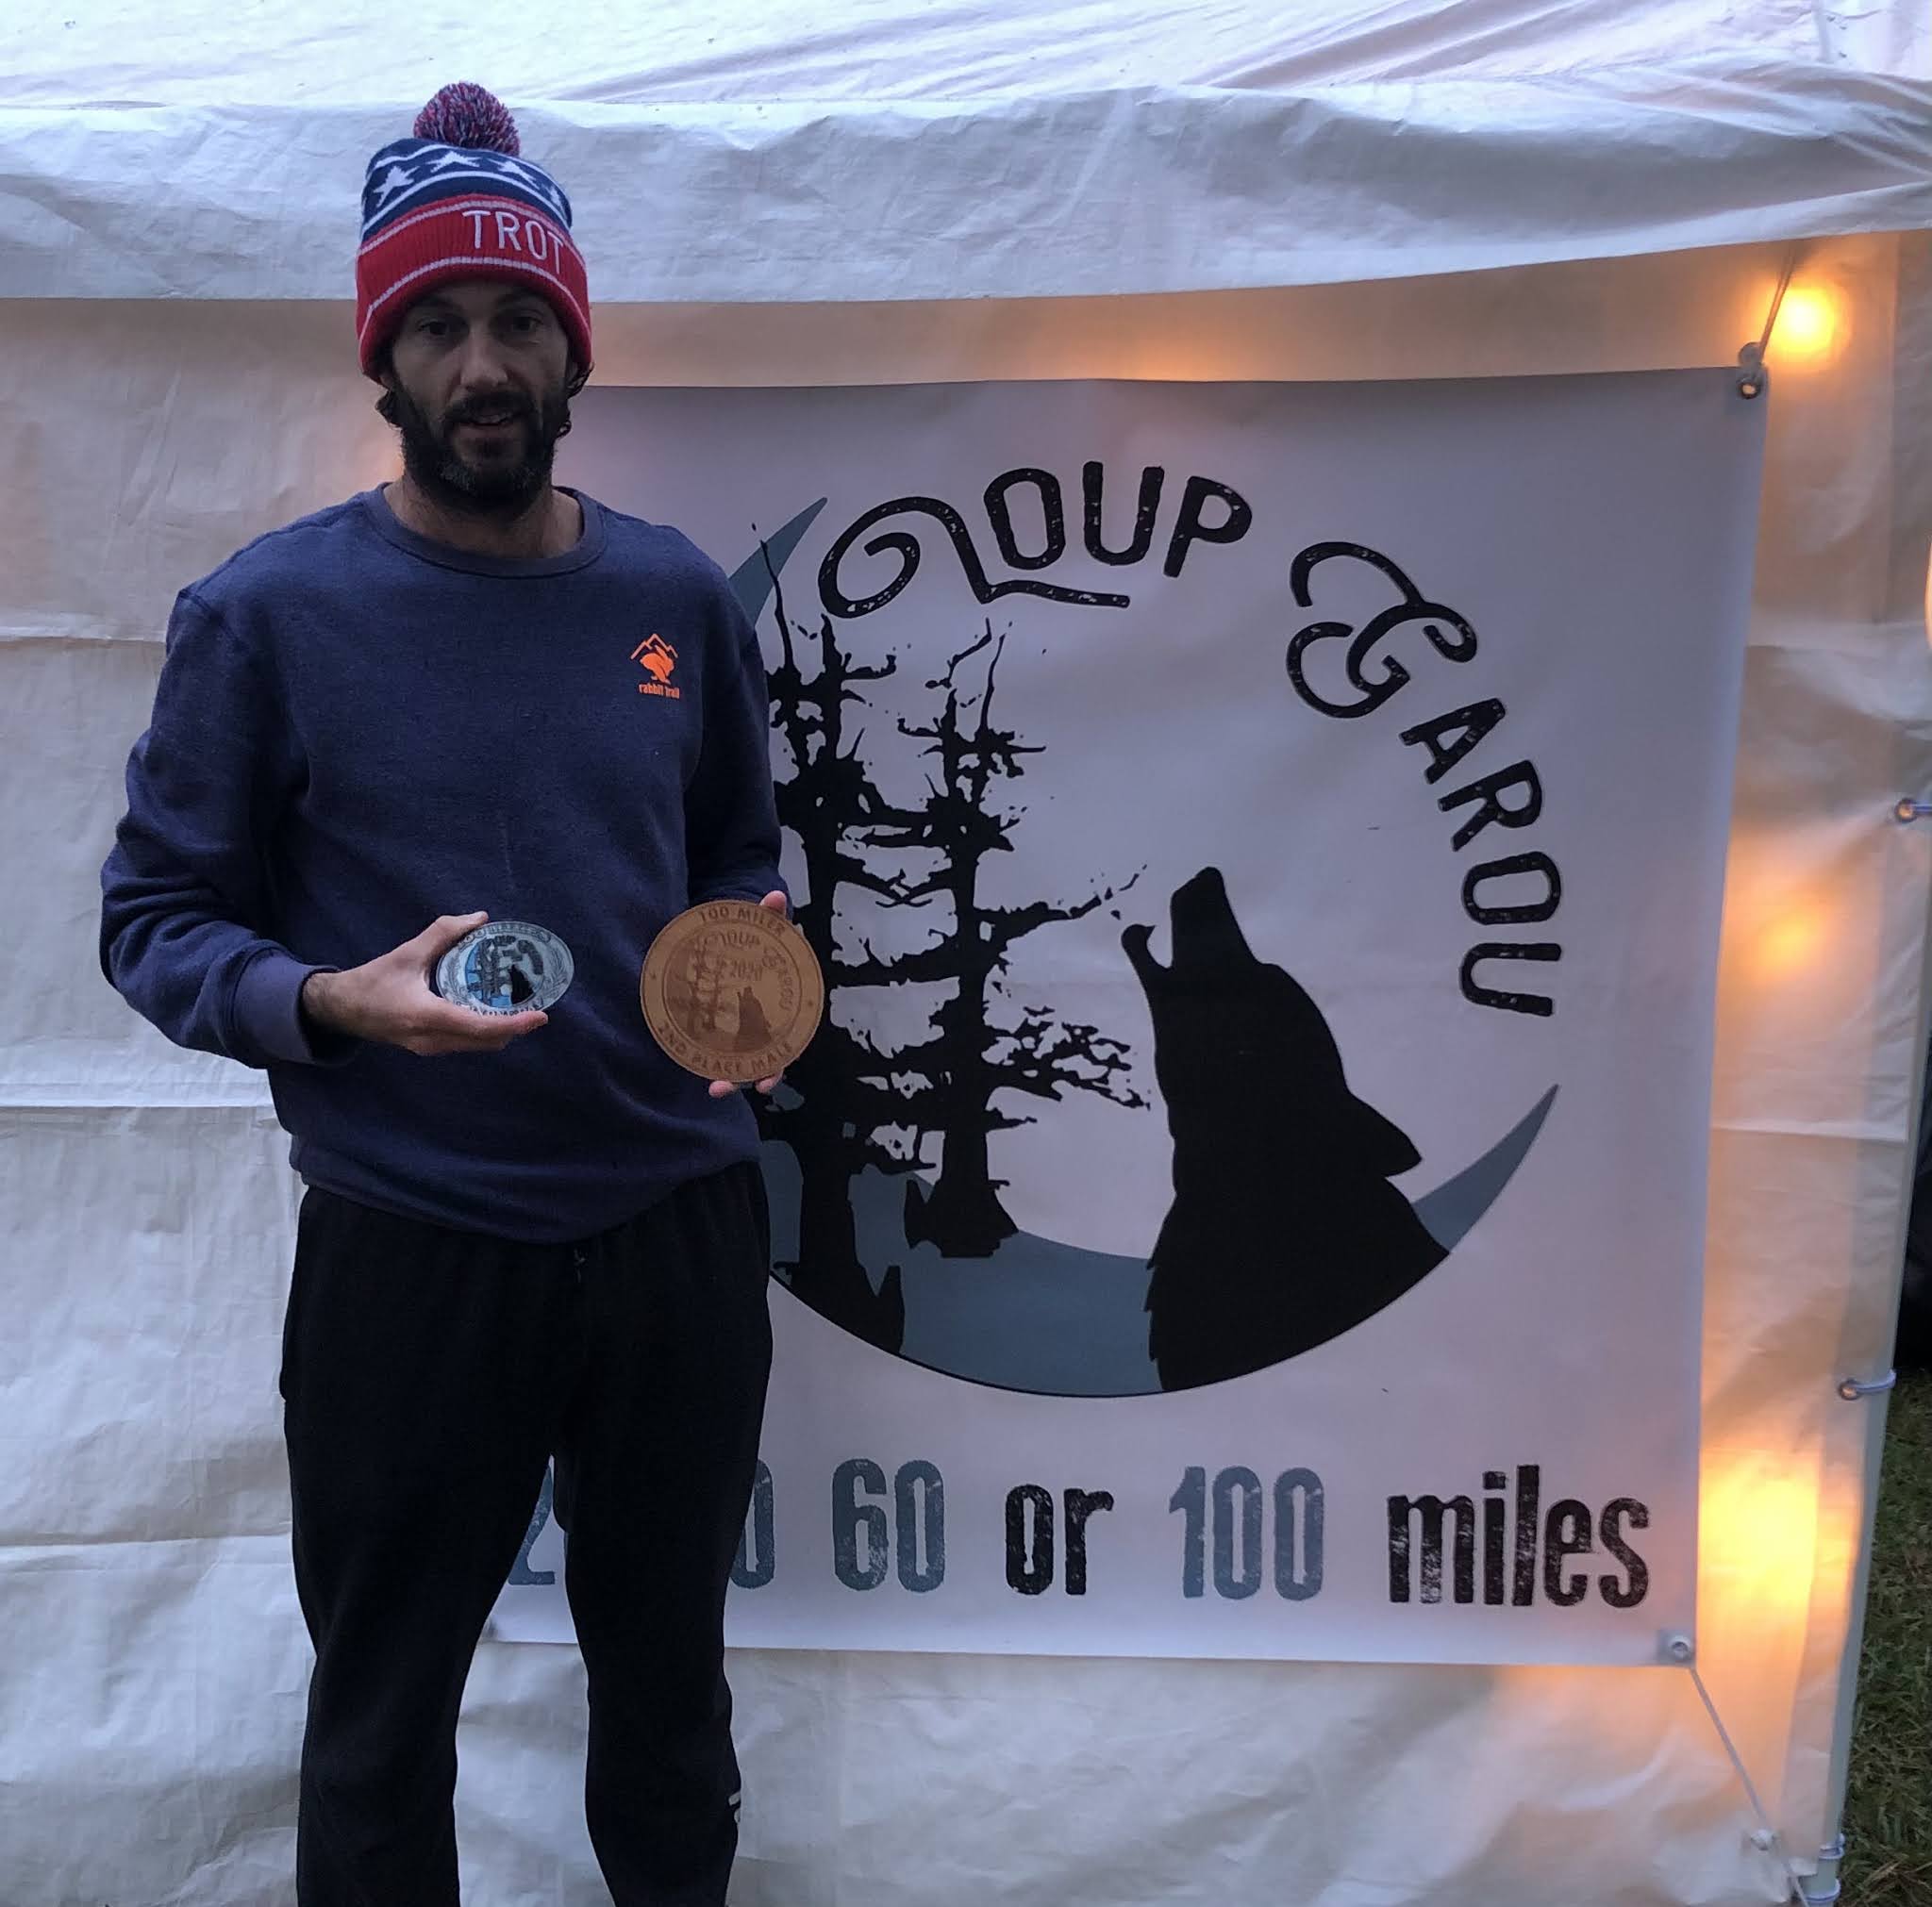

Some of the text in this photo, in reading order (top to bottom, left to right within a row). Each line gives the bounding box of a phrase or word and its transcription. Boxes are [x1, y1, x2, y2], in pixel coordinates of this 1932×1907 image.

[462, 209, 564, 274] TROT
[818, 460, 1562, 1017] LOUP GAROU
[700, 907, 729, 923] 100
[832, 1458, 945, 1592] 60
[1005, 1484, 1114, 1596] or
[1169, 1466, 1324, 1600] 100
[1387, 1464, 1649, 1608] miles
